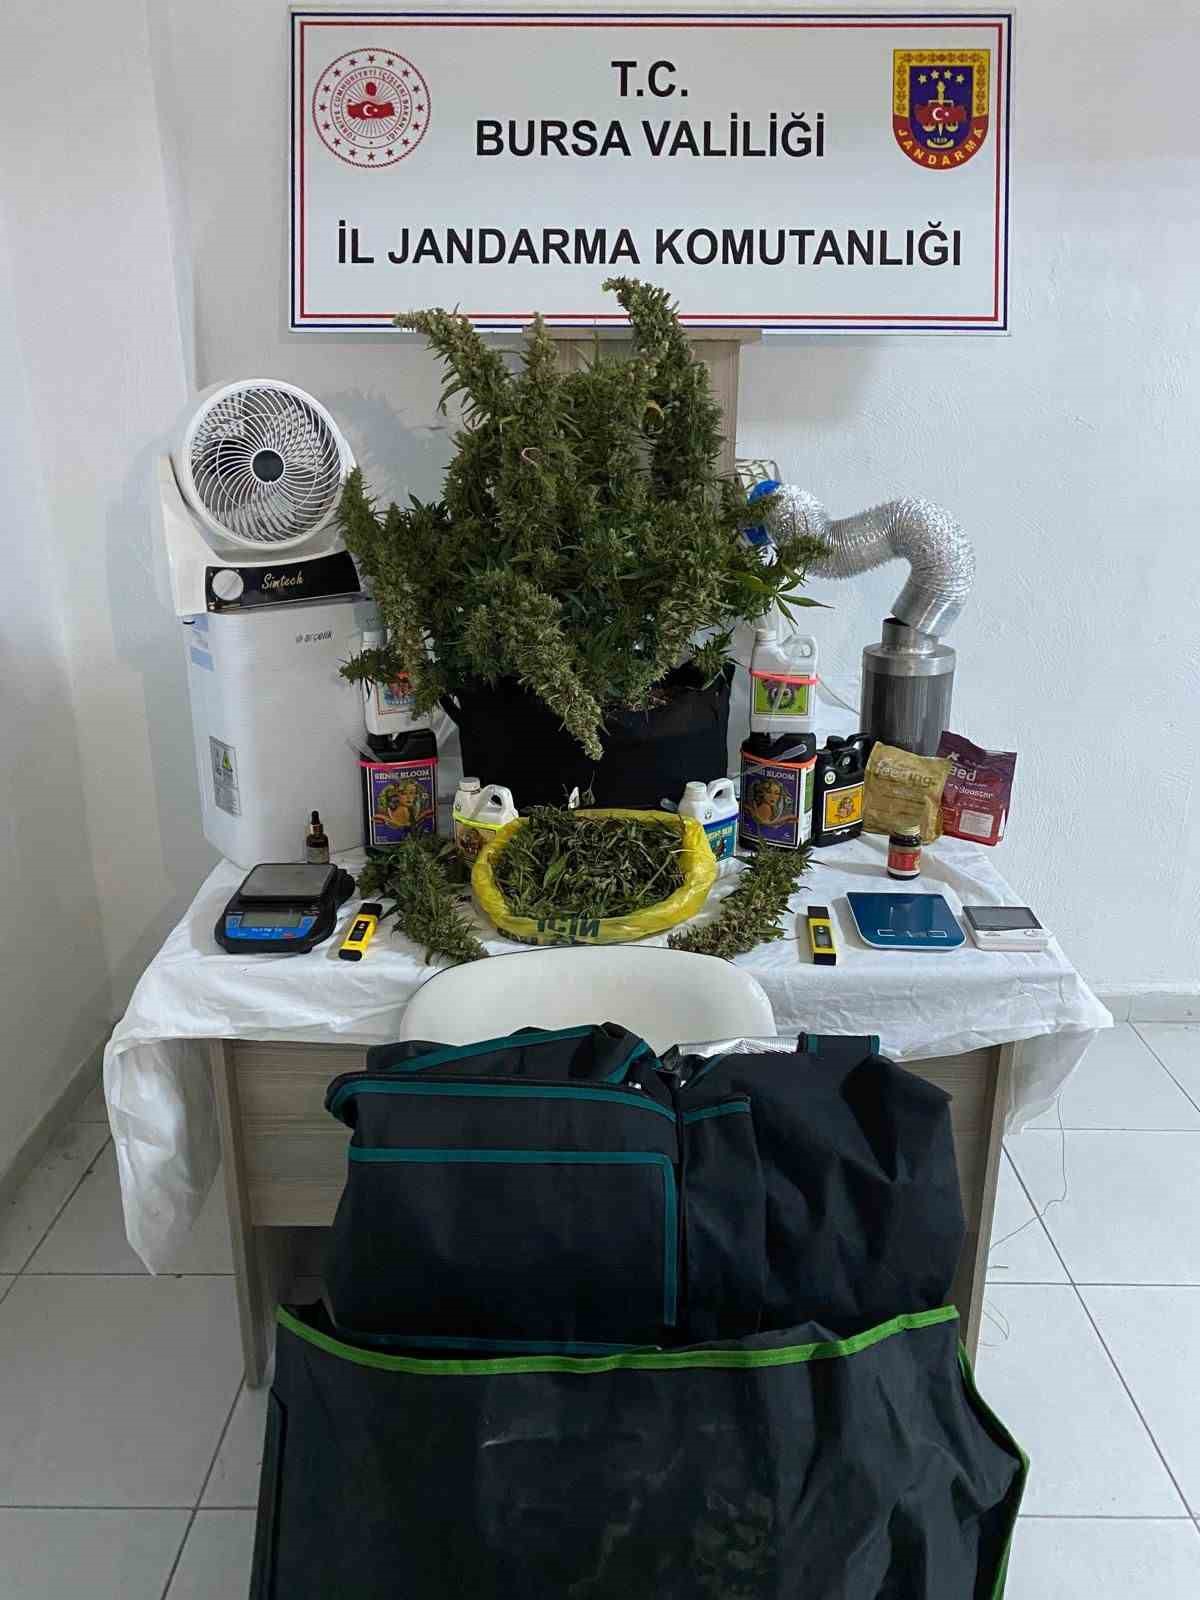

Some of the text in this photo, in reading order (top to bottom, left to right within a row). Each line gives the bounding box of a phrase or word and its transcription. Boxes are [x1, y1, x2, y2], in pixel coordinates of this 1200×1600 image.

[610, 60, 689, 98] T.C.
[477, 112, 826, 158] BURSA VALİLİĞİ
[897, 127, 984, 166] JANDARMA
[338, 219, 962, 266] İL JANDARMA KOMUTANLIĞI
